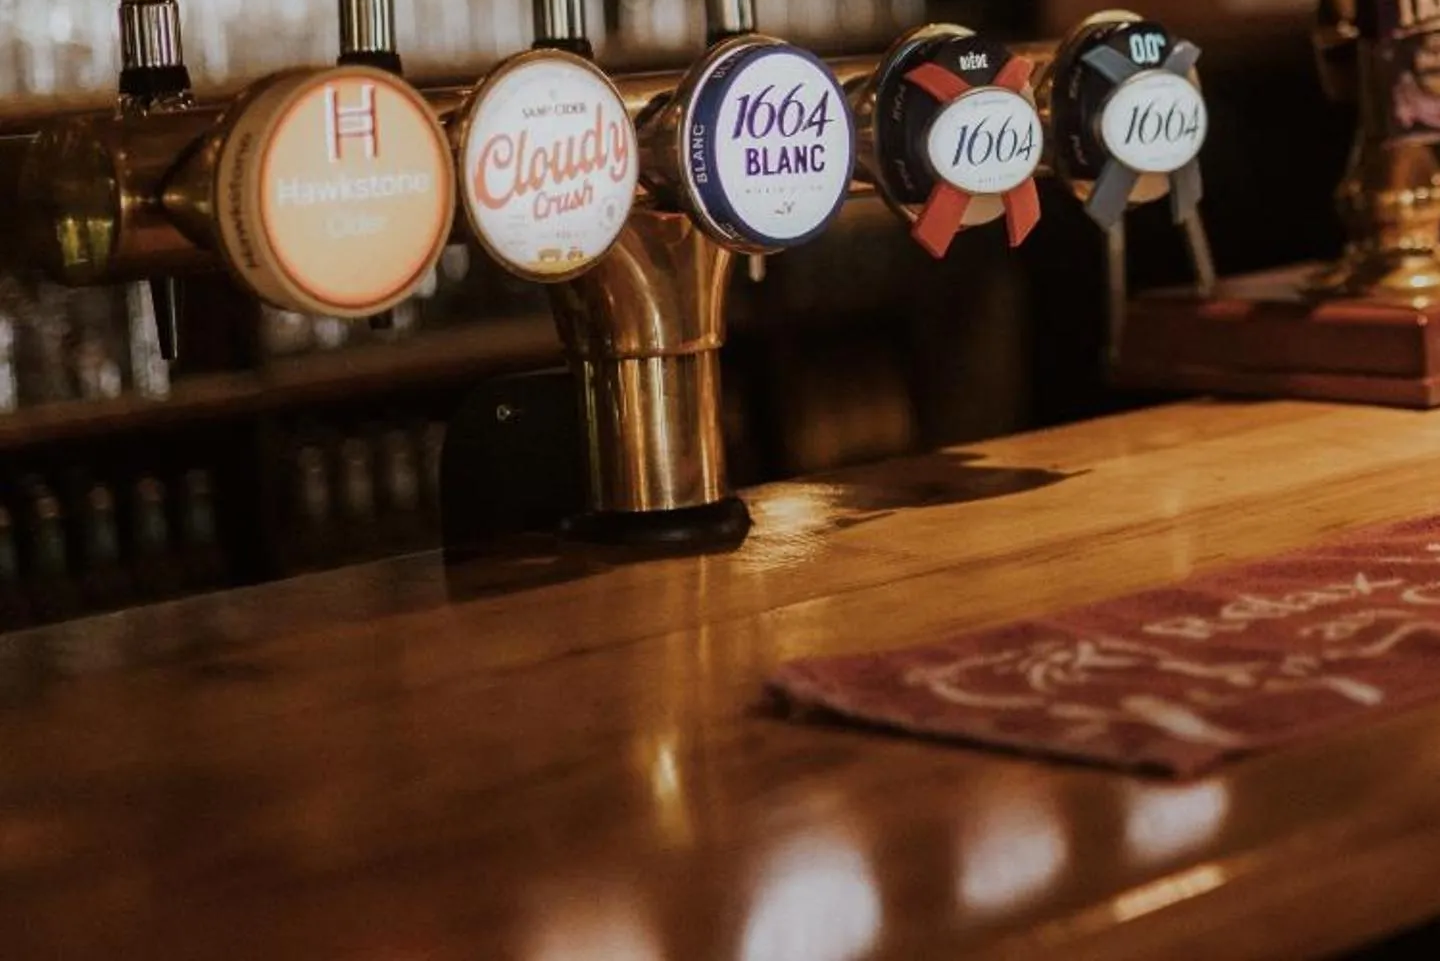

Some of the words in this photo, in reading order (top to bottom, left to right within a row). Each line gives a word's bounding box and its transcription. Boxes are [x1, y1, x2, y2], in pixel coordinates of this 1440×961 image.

[732, 82, 836, 139] 1664
[1124, 100, 1200, 145] 1664
[474, 102, 630, 210] Cloudy
[693, 124, 708, 183] BLANC
[745, 144, 826, 177] BLANC
[952, 114, 1037, 168] 1664
[277, 172, 430, 207] Hawkstone
[533, 178, 595, 221] Crush
